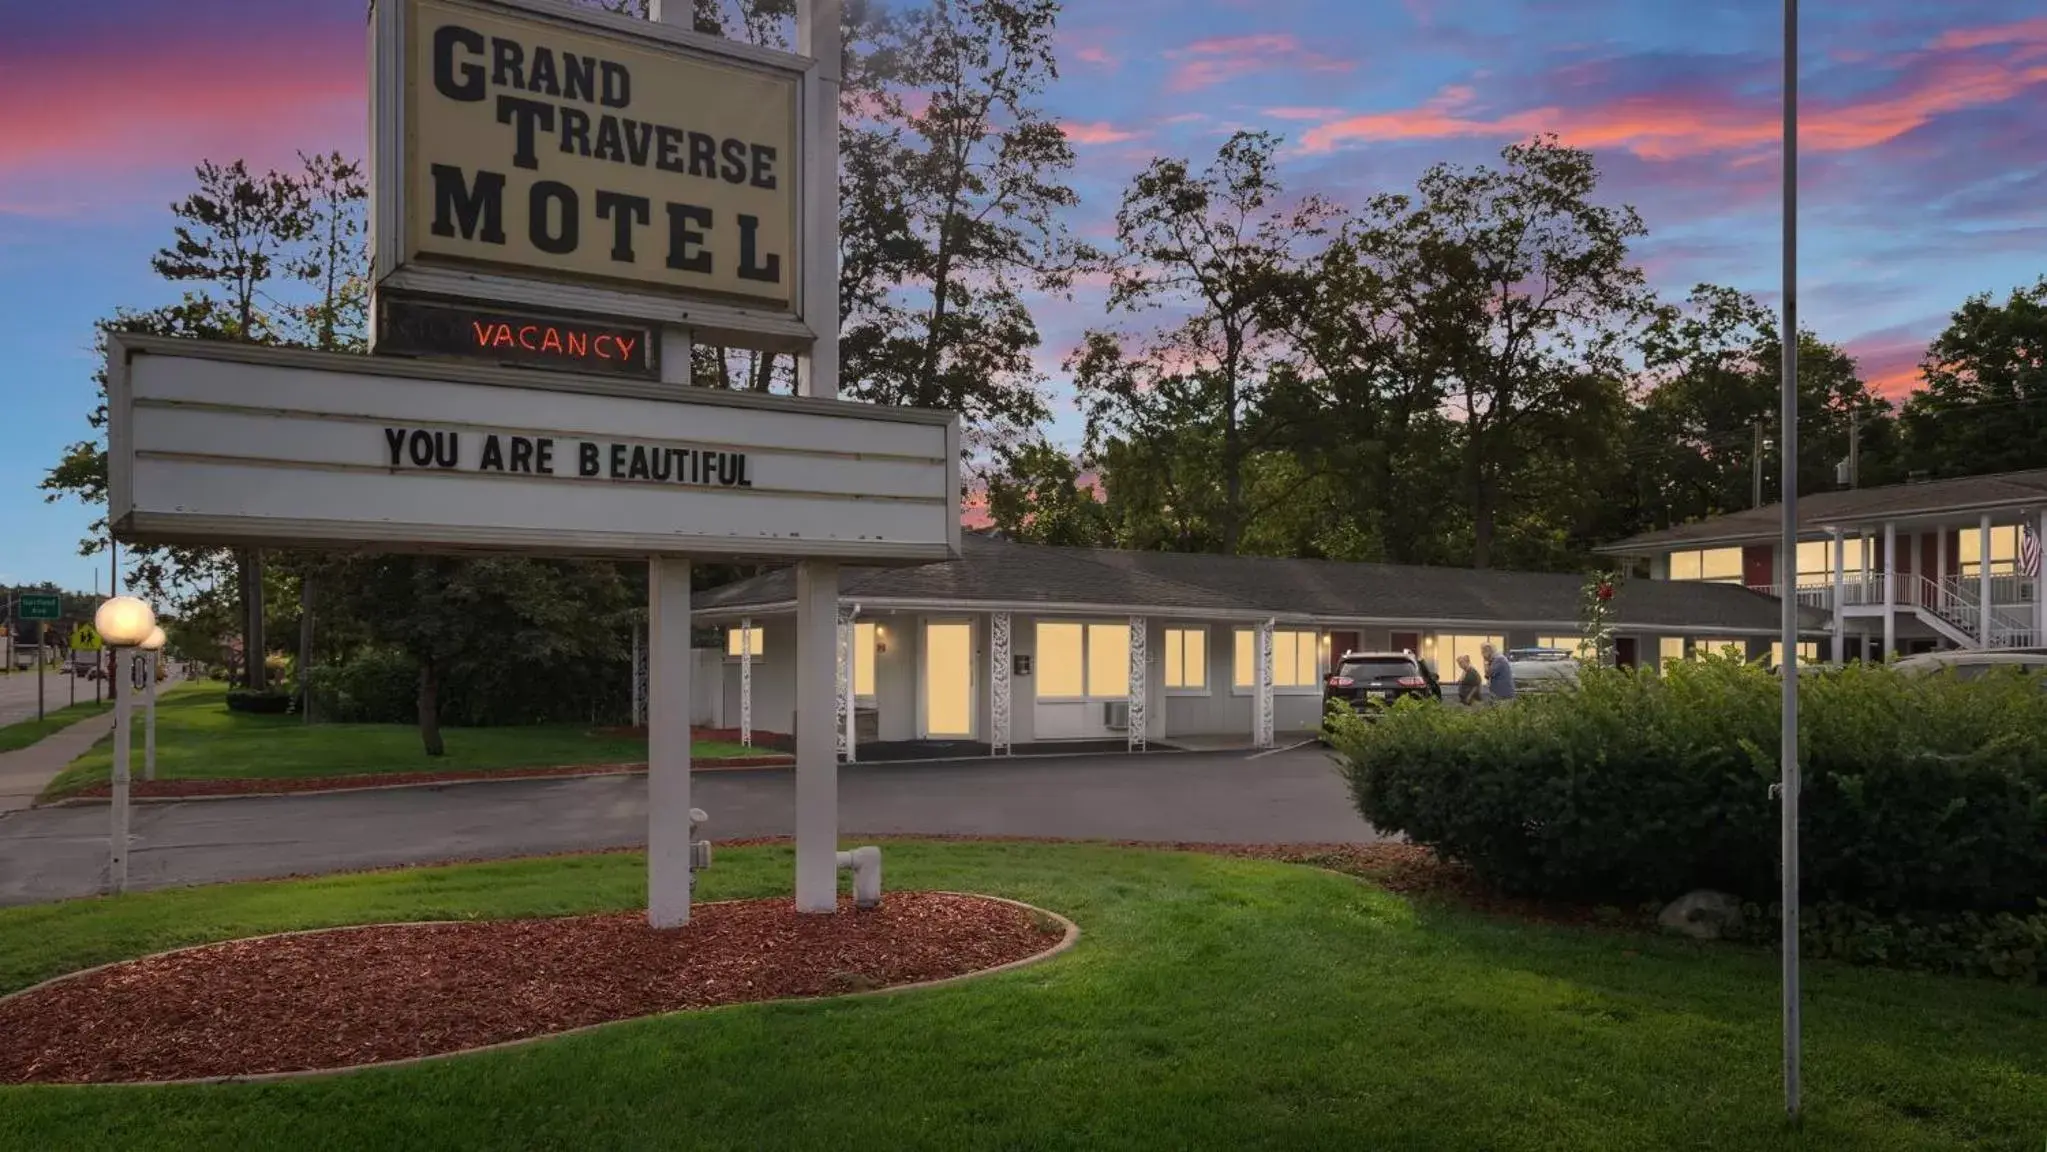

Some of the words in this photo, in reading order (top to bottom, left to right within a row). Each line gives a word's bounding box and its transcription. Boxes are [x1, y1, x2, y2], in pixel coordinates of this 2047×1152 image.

[433, 25, 630, 109] GRAND
[497, 95, 777, 190] TRAVERSE
[430, 163, 780, 283] MOTEL
[473, 320, 636, 361] VACANCY
[384, 427, 459, 468] YOU
[480, 434, 554, 474] ARE
[579, 441, 753, 487] BEAUTIFUL
